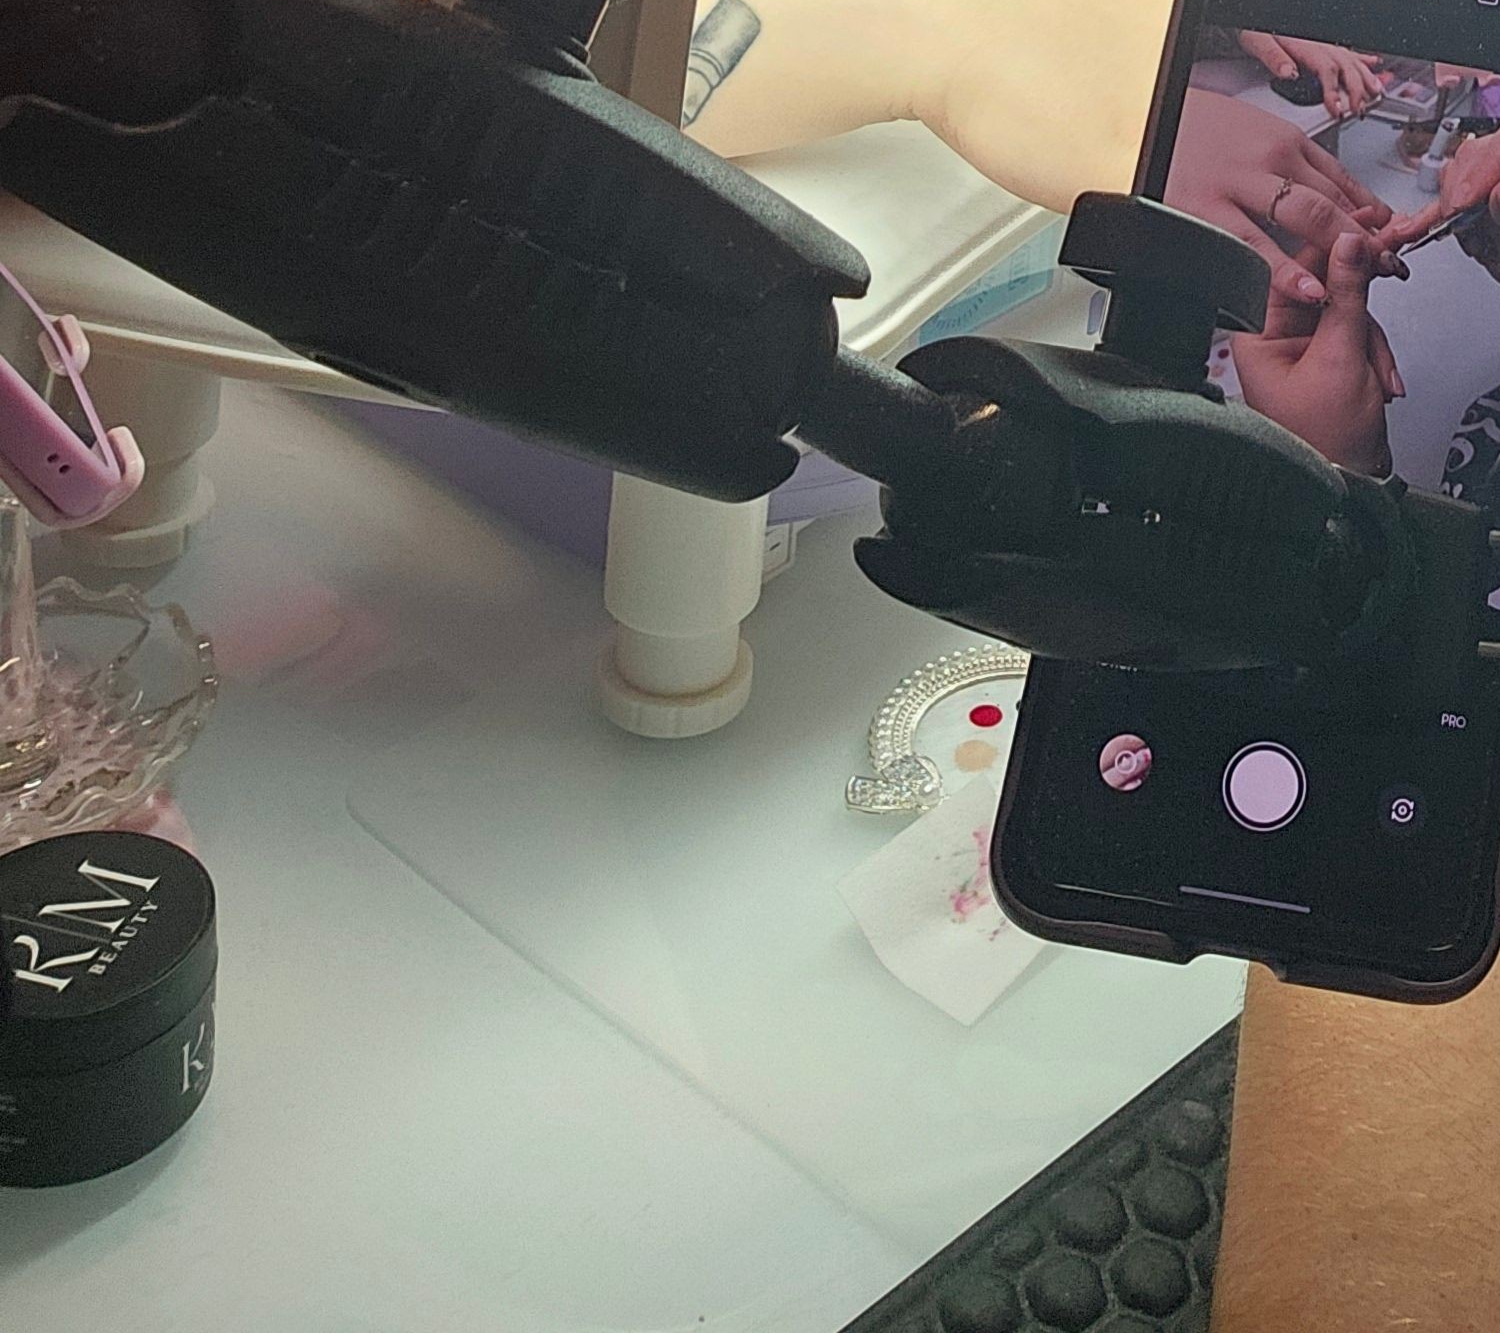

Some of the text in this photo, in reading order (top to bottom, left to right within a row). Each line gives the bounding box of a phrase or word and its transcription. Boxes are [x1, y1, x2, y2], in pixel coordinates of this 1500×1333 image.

[1441, 713, 1467, 729] PRO
[88, 897, 160, 977] BEAUTY
[181, 1021, 210, 1095] K
